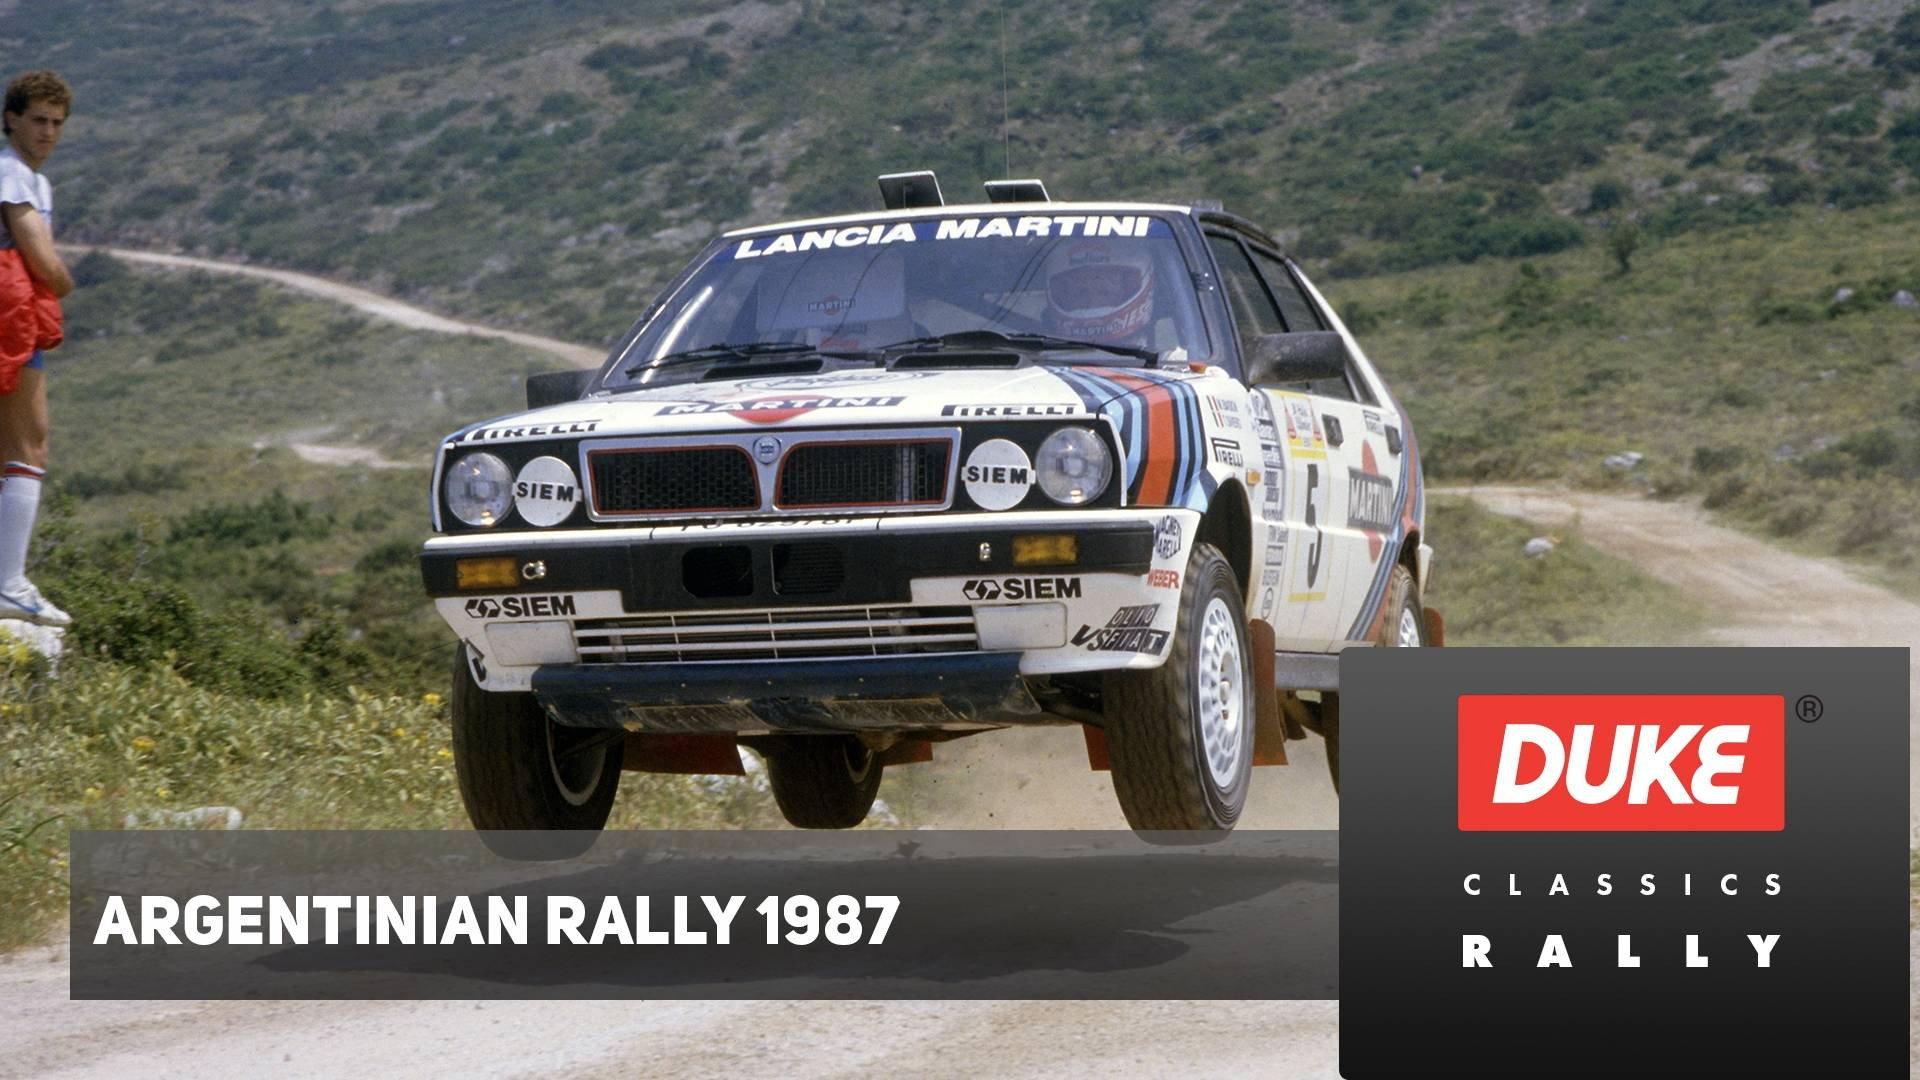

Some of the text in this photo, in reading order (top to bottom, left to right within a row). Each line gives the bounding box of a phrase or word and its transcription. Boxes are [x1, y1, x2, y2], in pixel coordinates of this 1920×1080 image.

[734, 216, 1150, 259] LANCIA MARTINI
[664, 395, 892, 414] MARTINI
[1211, 437, 1244, 467] PIRELLI
[967, 466, 1028, 484] SIEM
[517, 482, 574, 502] SIEM
[1306, 463, 1322, 589] 5
[1003, 577, 1082, 600] SIEM
[501, 594, 577, 618] SIEM
[1111, 607, 1155, 625] OLIO
